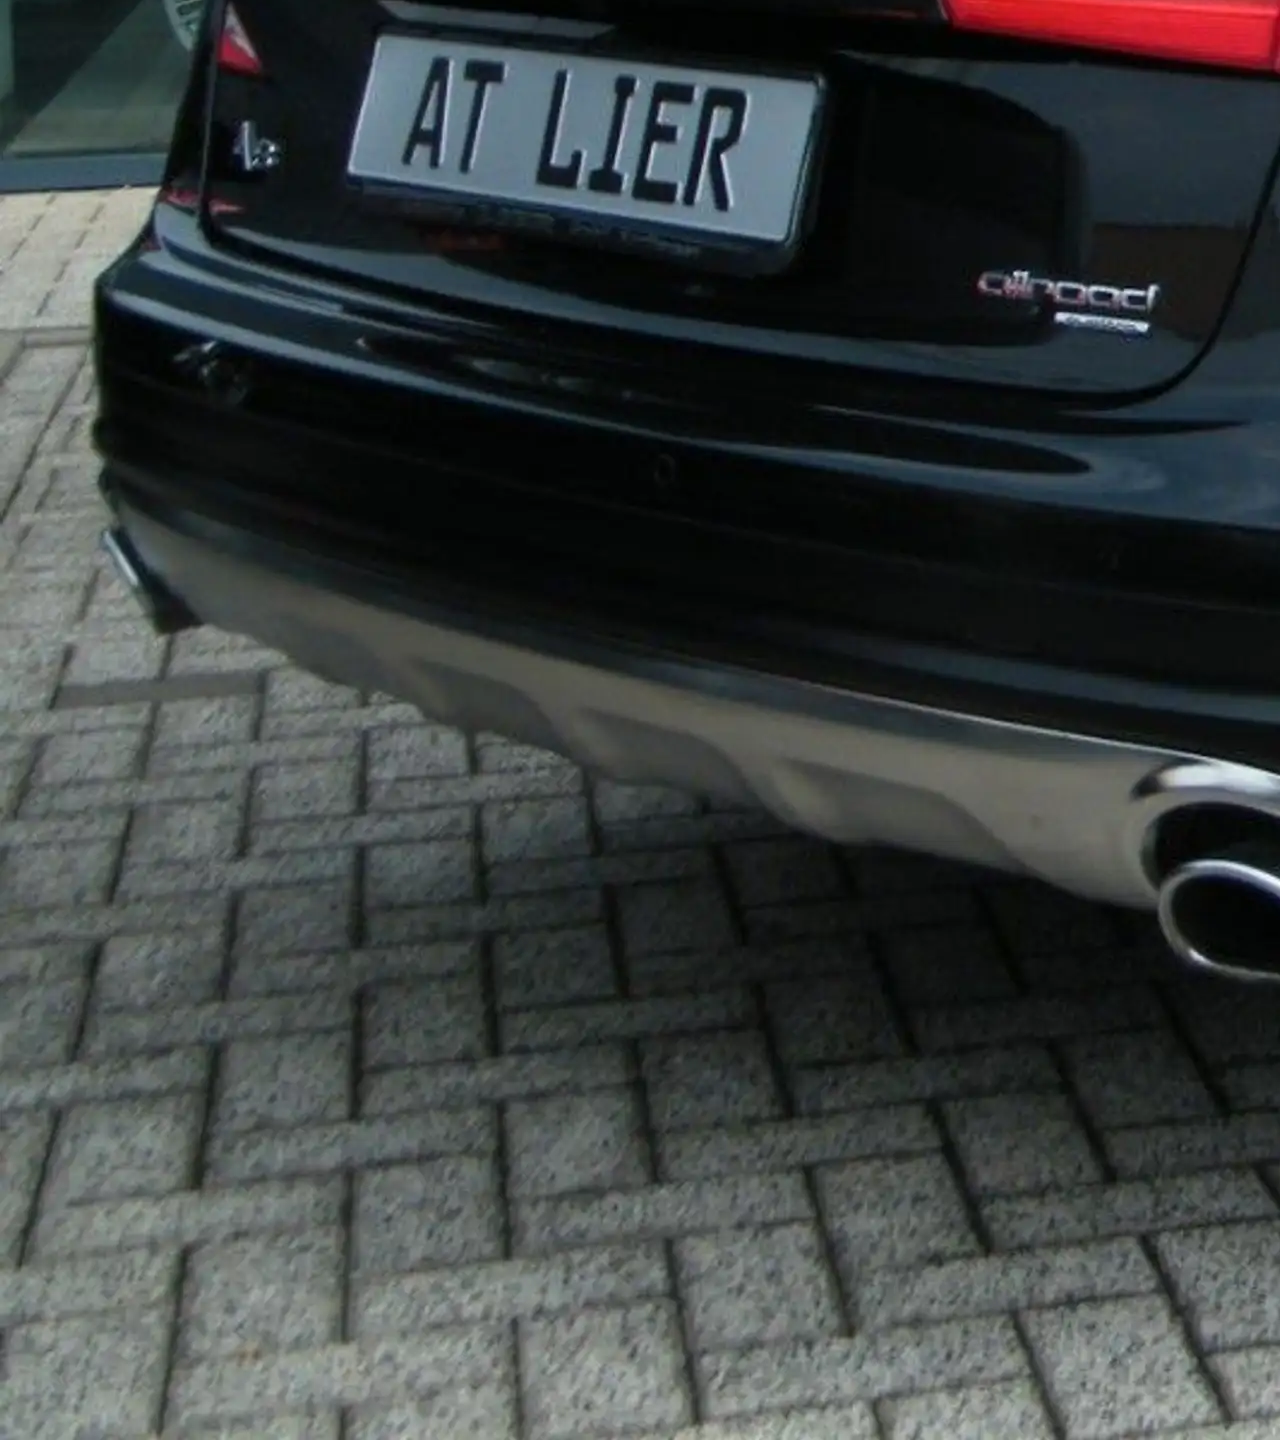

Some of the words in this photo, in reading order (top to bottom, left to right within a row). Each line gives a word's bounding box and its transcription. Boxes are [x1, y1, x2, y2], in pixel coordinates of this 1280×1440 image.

[401, 56, 506, 174] AT
[536, 69, 749, 211] LIER
[976, 269, 1161, 311] allroad
